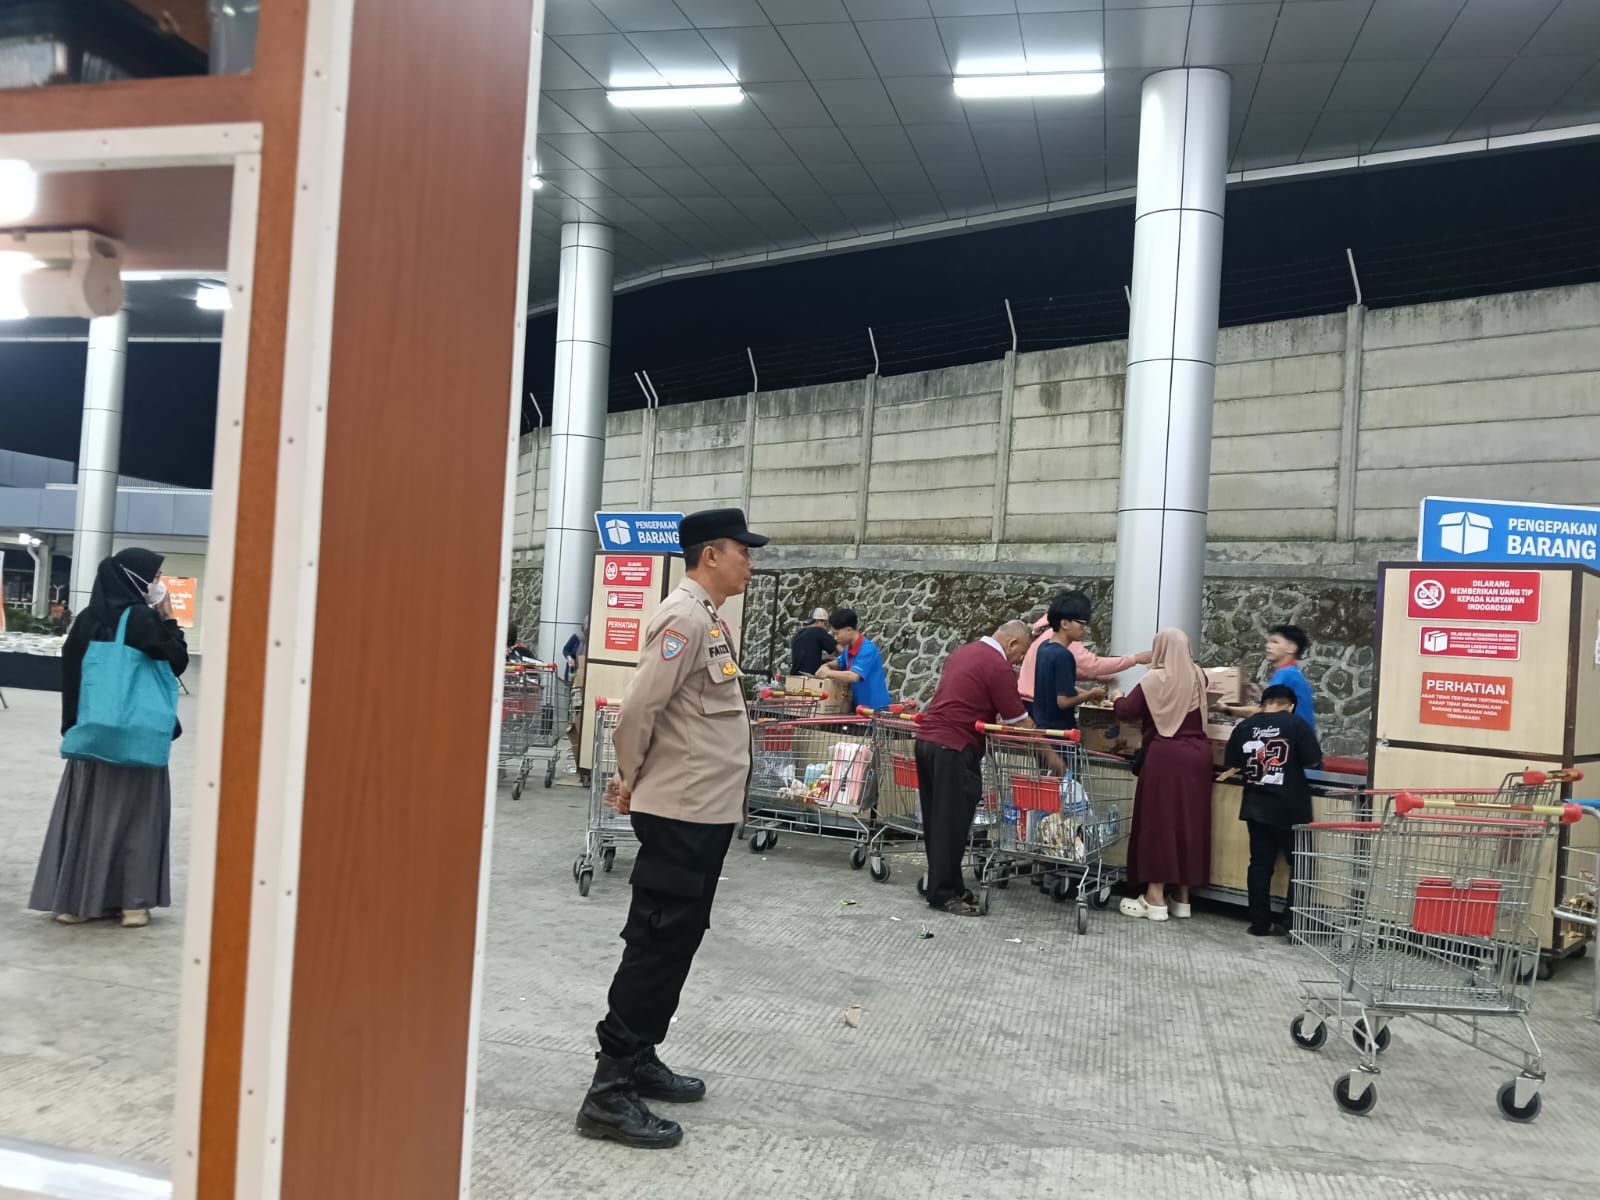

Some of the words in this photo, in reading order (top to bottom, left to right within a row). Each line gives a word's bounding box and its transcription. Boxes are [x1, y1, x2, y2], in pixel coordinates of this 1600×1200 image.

[635, 520, 678, 529] PENGEPAKAN
[1508, 518, 1597, 536] PENGEPAKAN
[637, 531, 680, 544] BARANG
[1507, 534, 1597, 560] BARANG
[1472, 580, 1510, 588] DILARANG
[1450, 587, 1499, 595] MEMBERIKAN
[1500, 588, 1520, 596] UANG
[1457, 595, 1485, 603] KEPADA
[1485, 596, 1525, 604] KARYAWAN
[1468, 603, 1513, 612] INDOGROSIR
[1426, 679, 1506, 696] PERHATIAN
